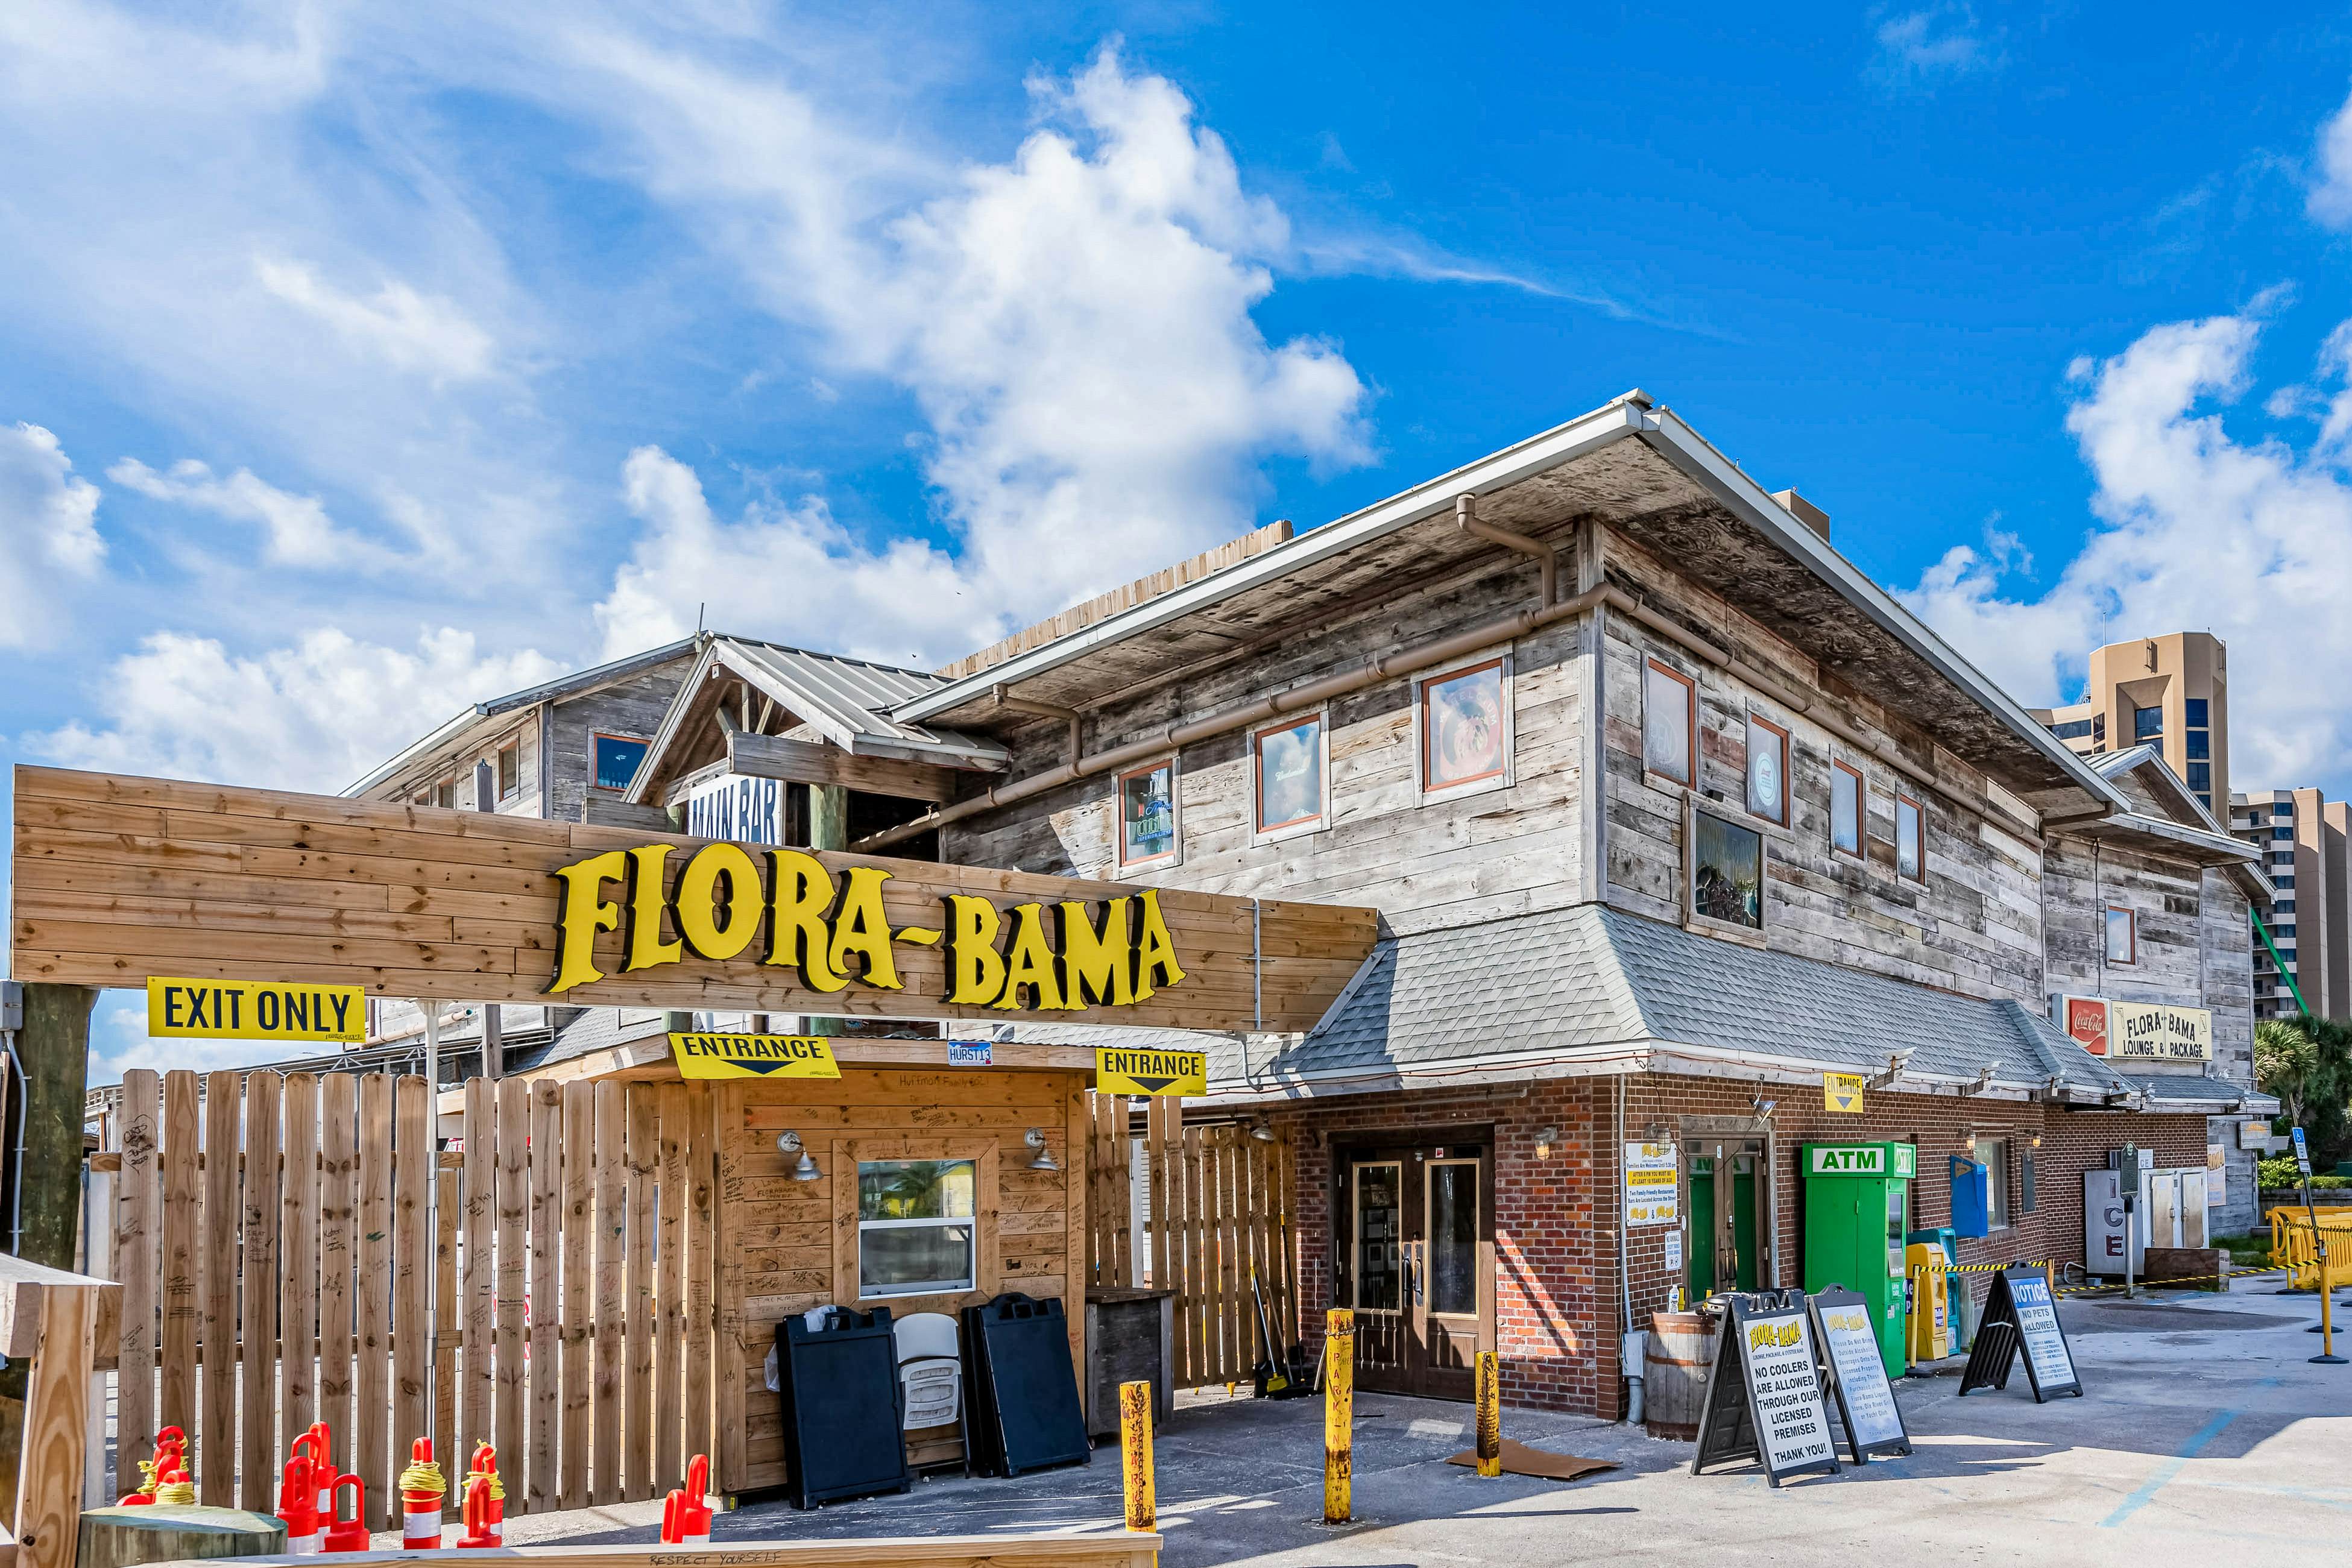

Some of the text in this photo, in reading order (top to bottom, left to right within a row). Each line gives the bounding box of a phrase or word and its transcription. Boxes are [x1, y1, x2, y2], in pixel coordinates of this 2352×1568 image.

[693, 778, 776, 845] MAIN BAR
[165, 986, 350, 1033] EXIT ONLY
[681, 1036, 825, 1059] ENTRANCE
[950, 1049, 991, 1060] HURST13
[2123, 1039, 2202, 1057] LOUNGE & PACKAGE
[1104, 1052, 1200, 1076] ENTRANCE
[1827, 1075, 1860, 1095] ENTRANCE
[1821, 1151, 1876, 1169] ATM
[2011, 1283, 2050, 1303] NOTICE
[2022, 1308, 2050, 1319] NO PETS
[2025, 1321, 2055, 1332] ALLOWED
[1755, 1360, 1809, 1379] NO COOLERS
[1757, 1375, 1814, 1395] ARE ALLOWED
[1758, 1390, 1820, 1411] THROUGH OUR
[1771, 1407, 1812, 1425] LICENSED
[1774, 1423, 1817, 1441] PREMISES
[1774, 1443, 1827, 1463] THANK YOU!
[649, 1551, 783, 1566] RESPECT YOURSELF
